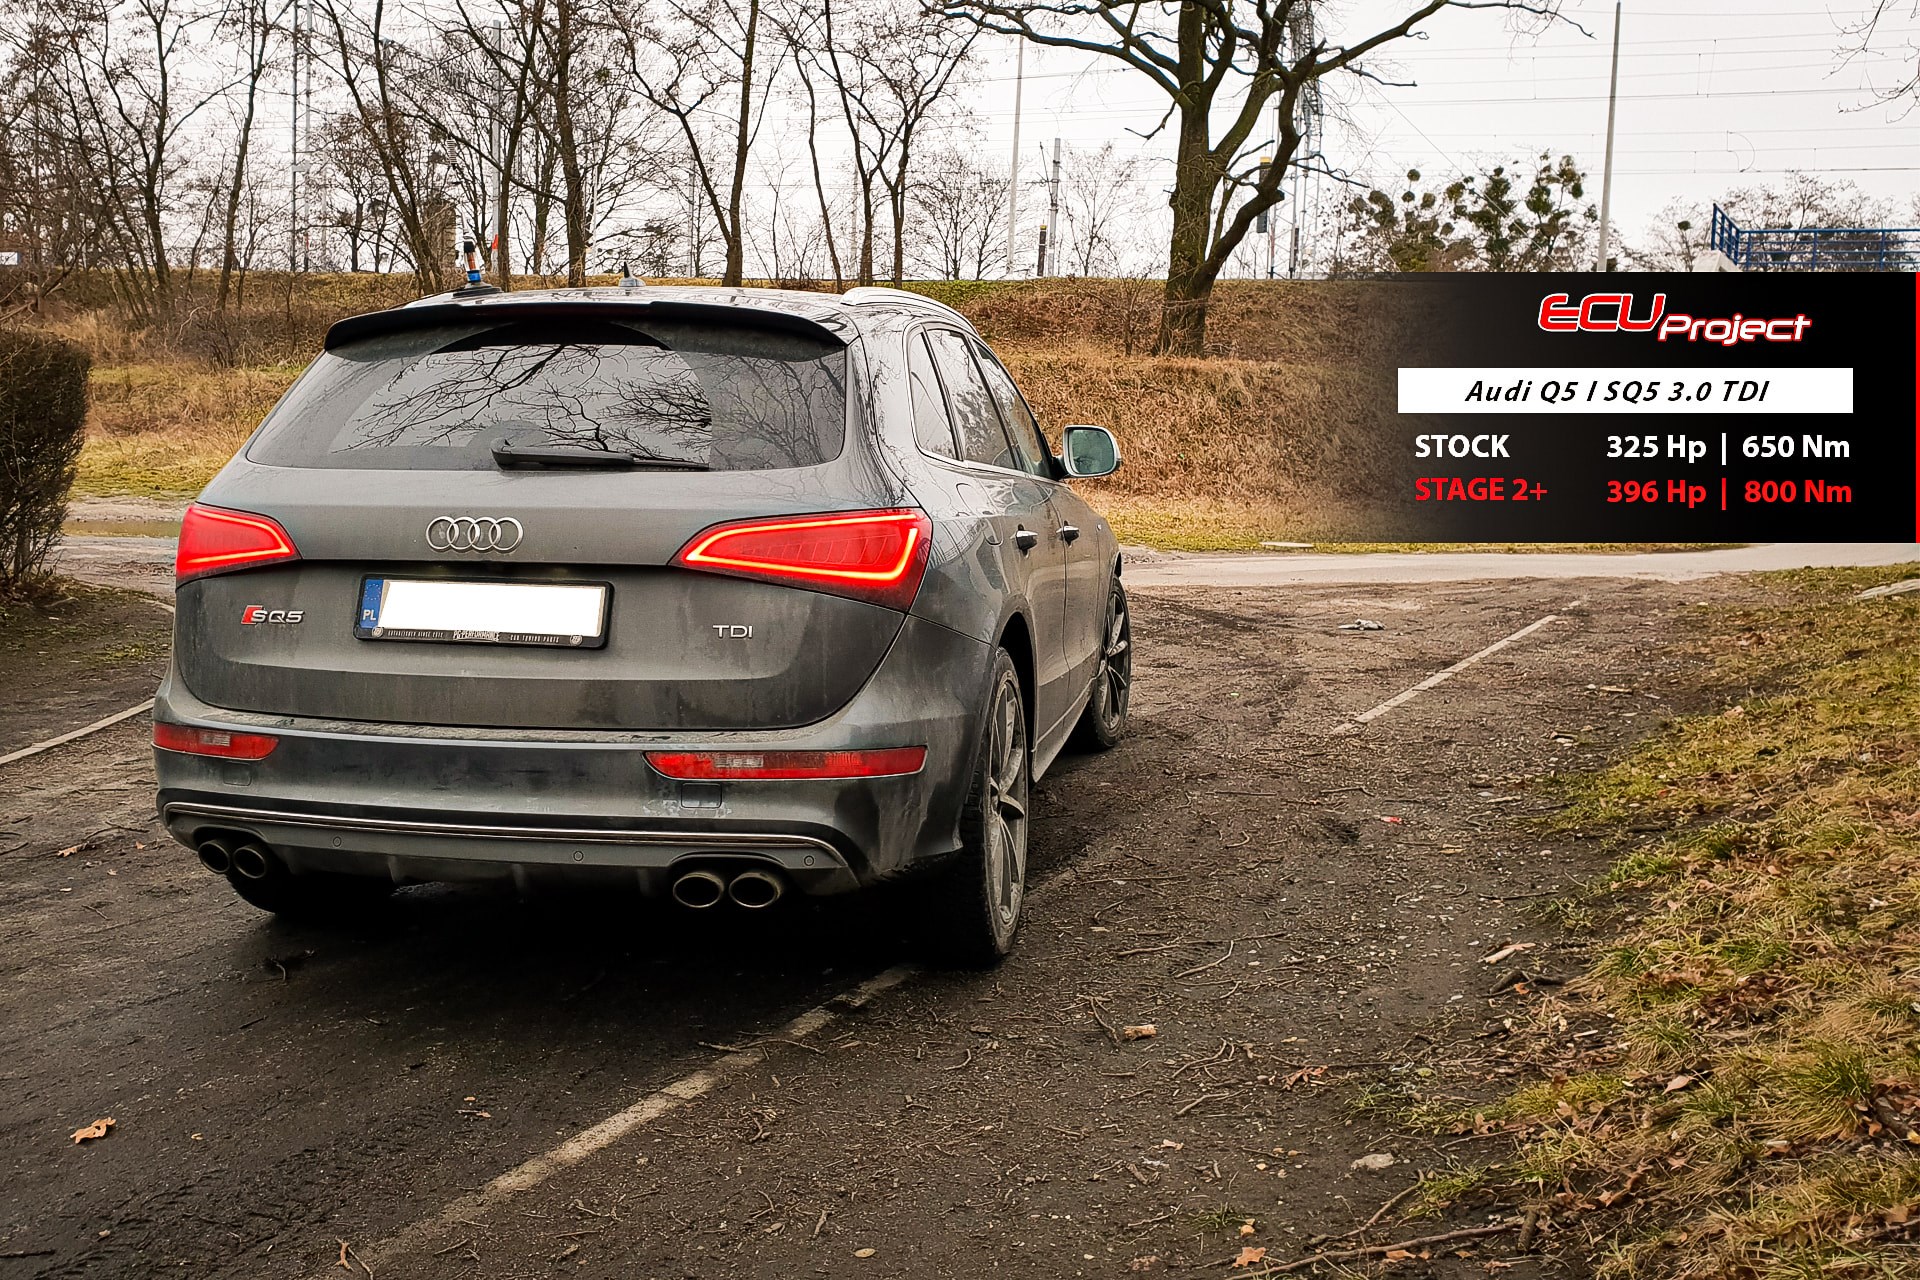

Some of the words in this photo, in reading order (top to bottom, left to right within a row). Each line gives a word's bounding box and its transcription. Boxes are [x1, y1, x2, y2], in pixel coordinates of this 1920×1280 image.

[250, 609, 304, 624] SQ5
[363, 609, 377, 620] PL
[712, 624, 753, 638] TDI
